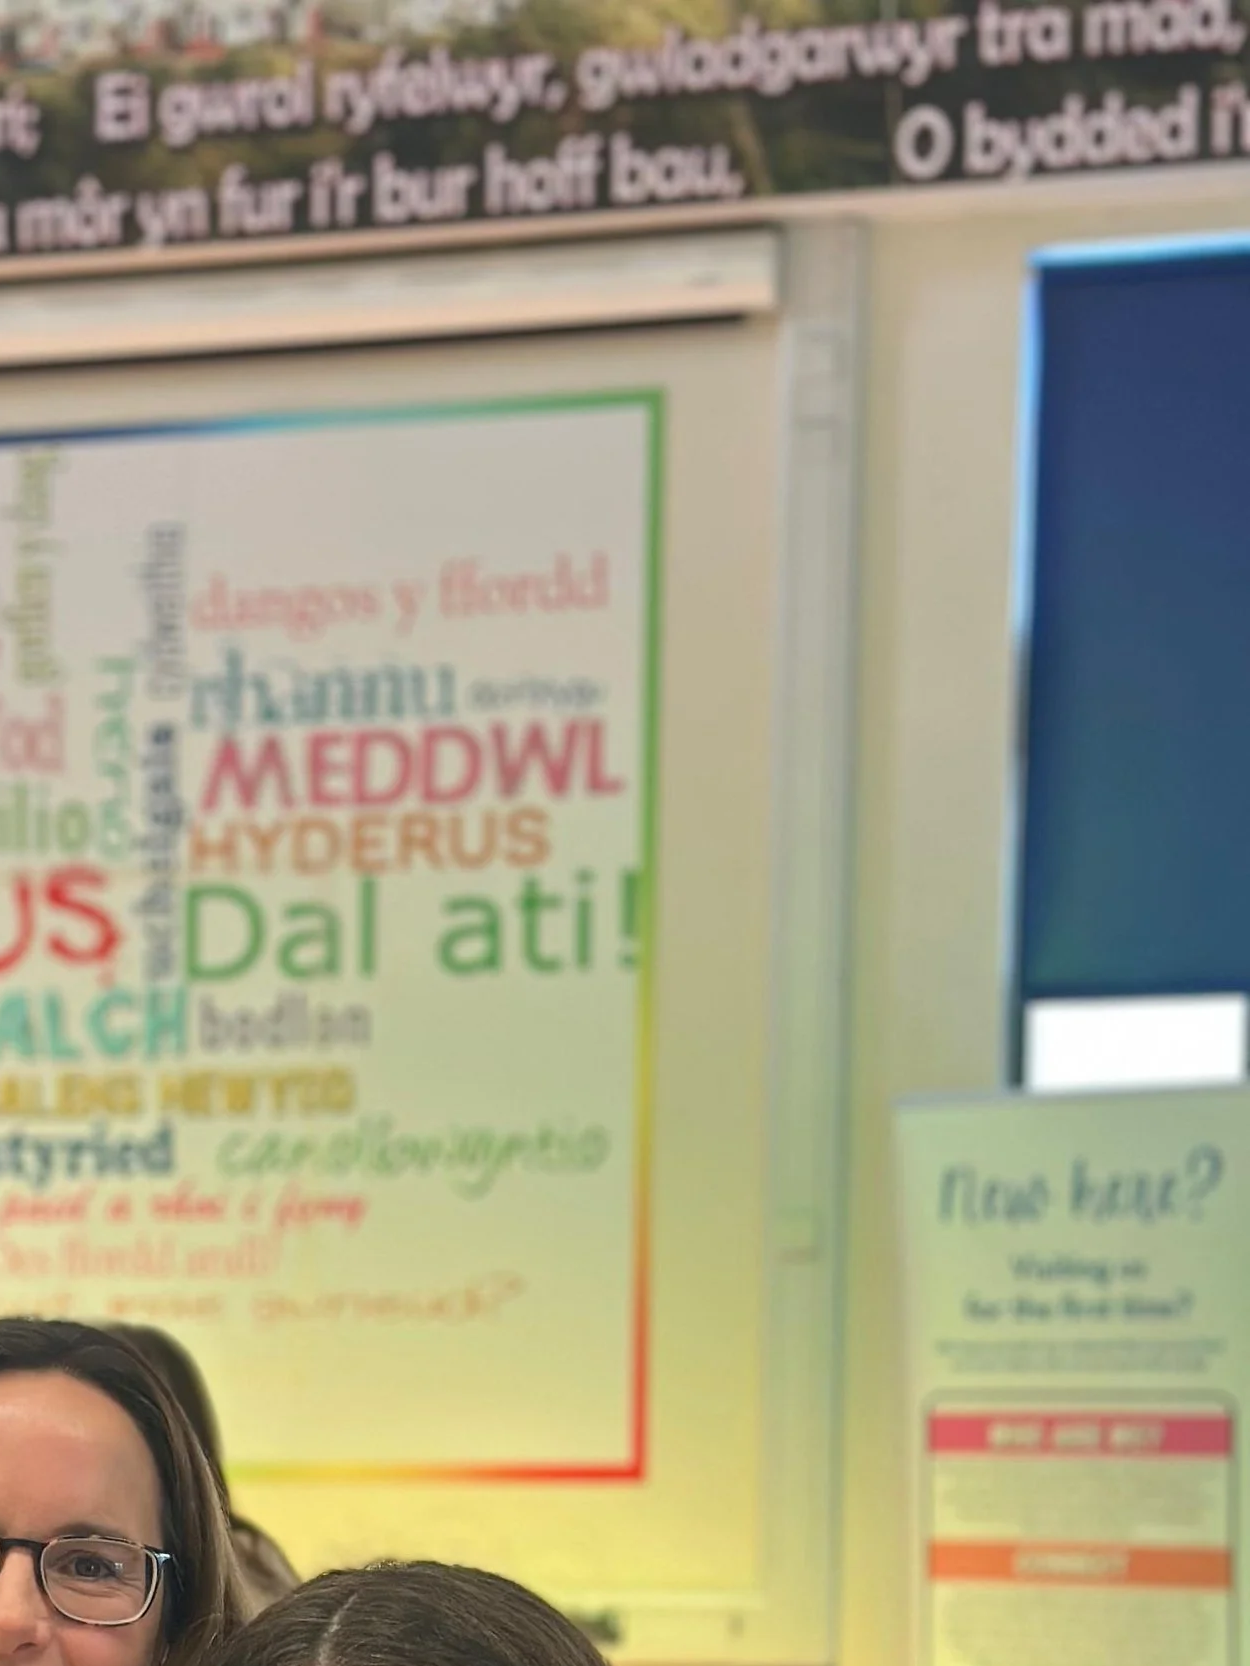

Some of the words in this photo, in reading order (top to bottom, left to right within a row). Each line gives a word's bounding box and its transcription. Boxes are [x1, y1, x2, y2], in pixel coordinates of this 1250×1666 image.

[93, 70, 150, 143] Ei
[156, 54, 315, 148] gwrol
[322, 47, 568, 135] ryfelwyr,
[574, 17, 970, 112] gwladgarwyr
[975, 0, 1072, 66] tra
[895, 103, 955, 182] O
[962, 80, 1200, 182] bydded
[15, 172, 132, 250] môr
[134, 185, 212, 255] yn
[218, 160, 300, 237] fur
[370, 150, 477, 225] bur
[483, 132, 603, 216] hoff
[609, 129, 747, 205] bau,
[393, 581, 424, 636] y
[200, 718, 625, 811] MEDDWL
[190, 806, 554, 876] HYDERUS
[186, 875, 378, 982] Dal
[438, 868, 645, 975] ati!
[1069, 1143, 1226, 1225] here?
